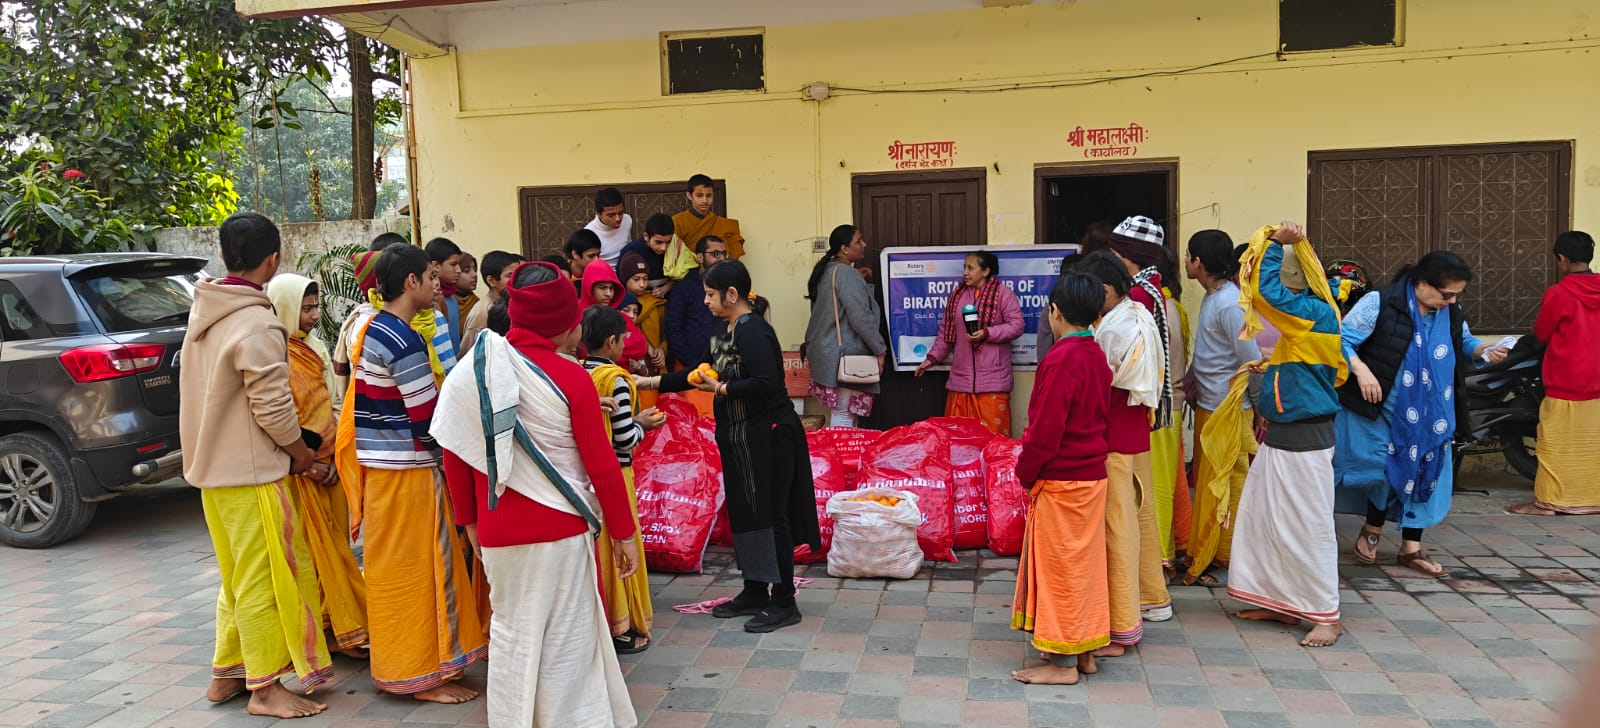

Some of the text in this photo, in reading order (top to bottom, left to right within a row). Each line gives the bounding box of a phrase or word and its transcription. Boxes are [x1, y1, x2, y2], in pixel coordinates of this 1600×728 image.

[1067, 126, 1084, 147] श्री
[928, 281, 961, 294] ROTA
[1018, 279, 1035, 293] OF
[903, 296, 948, 310] BIRATN
[960, 514, 987, 524] KORE
[641, 534, 667, 544] REAN
